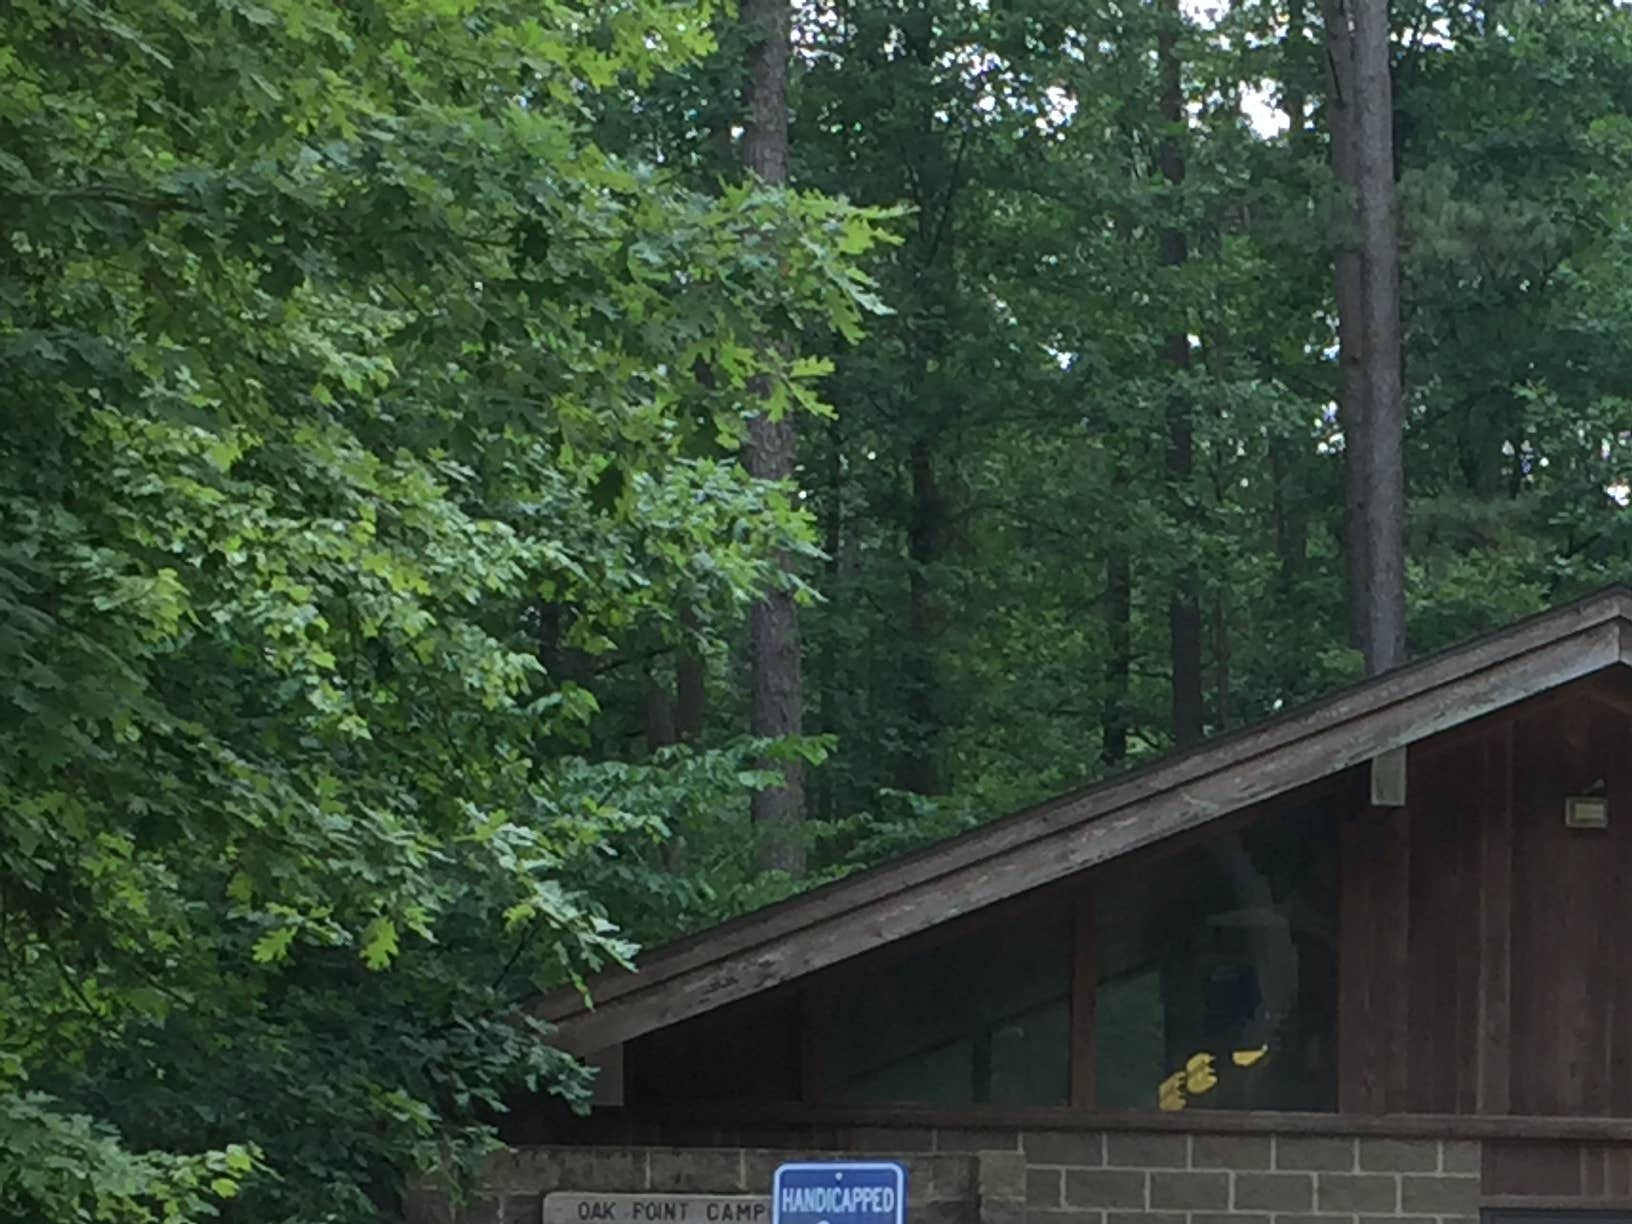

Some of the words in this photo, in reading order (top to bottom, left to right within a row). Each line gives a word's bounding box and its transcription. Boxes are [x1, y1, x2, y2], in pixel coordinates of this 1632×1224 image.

[577, 1202, 616, 1220] OAK
[632, 1202, 688, 1220] POINT
[782, 1187, 894, 1213] HANDICAPPED
